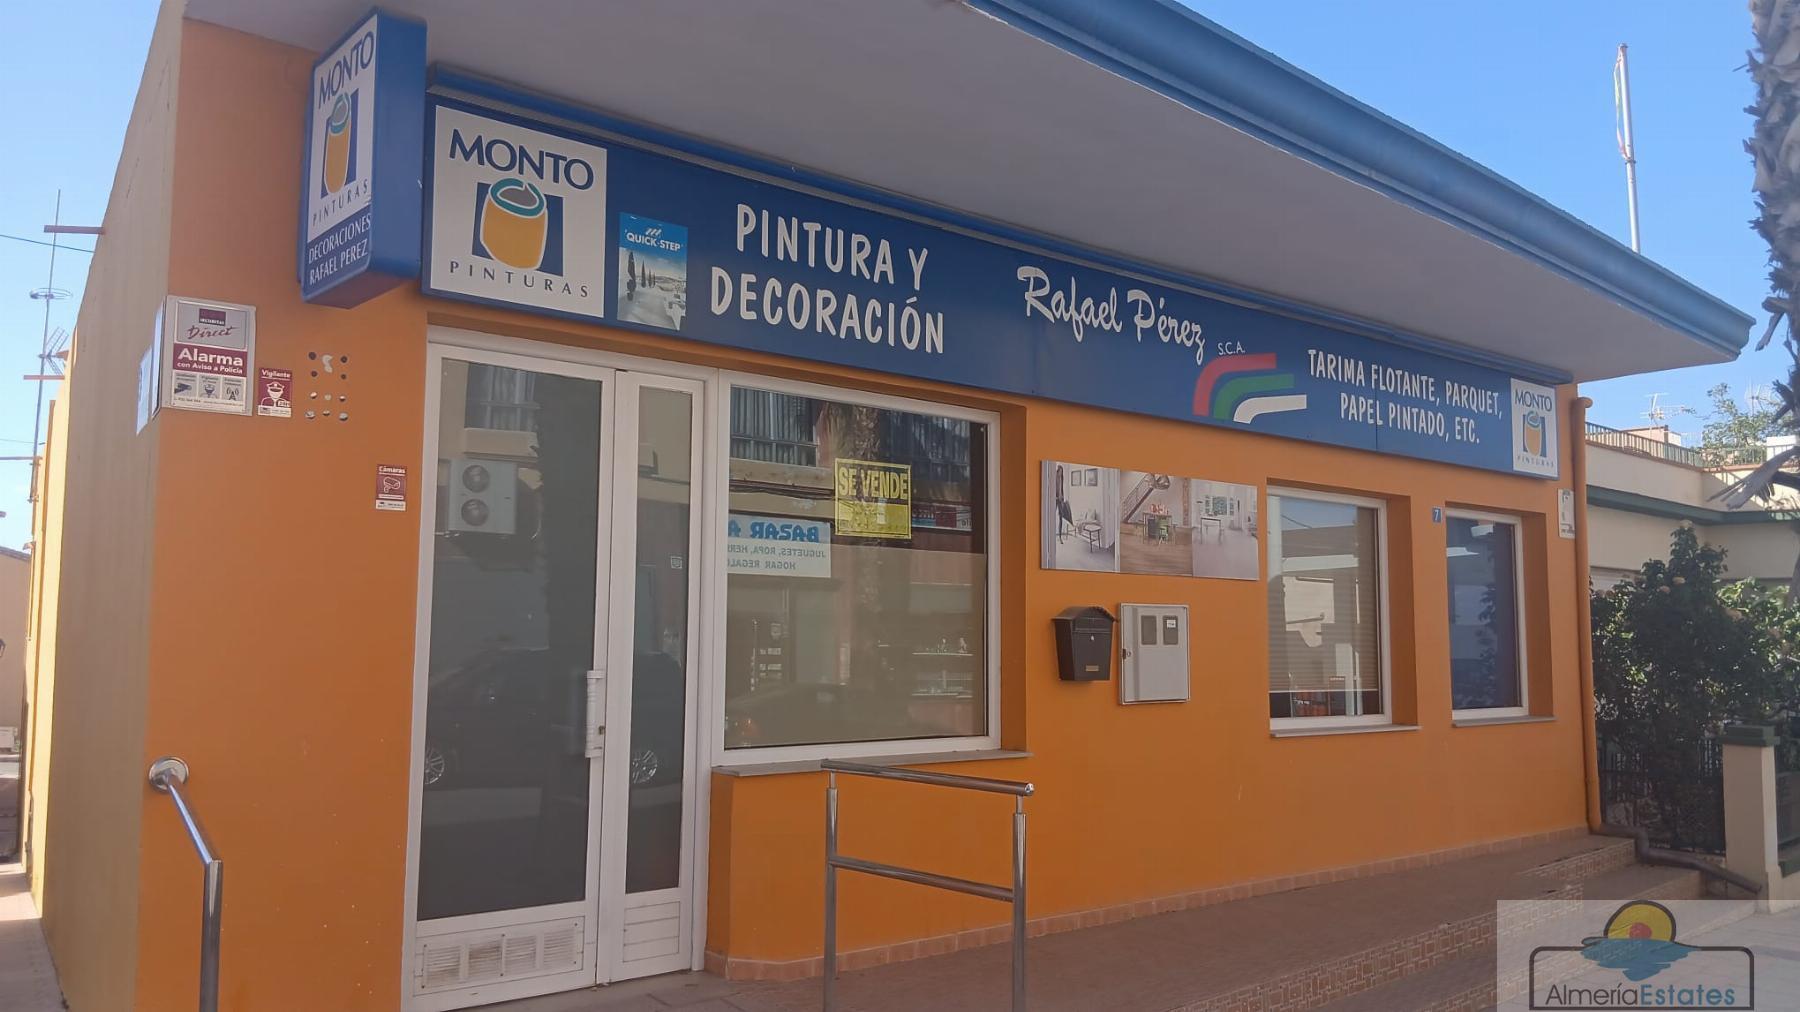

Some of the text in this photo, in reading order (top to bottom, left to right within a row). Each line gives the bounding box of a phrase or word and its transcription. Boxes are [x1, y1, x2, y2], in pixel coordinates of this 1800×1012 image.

[318, 31, 375, 110] MONTO
[449, 128, 595, 191] MONTO
[313, 179, 368, 227] PINTURAS
[308, 213, 371, 265] DECORACIONES
[309, 238, 369, 286] RAFAEL PEREZ
[626, 232, 681, 252] QUICK-STEP
[737, 203, 928, 291] PINTURA Y
[449, 261, 589, 299] PINTURAS
[187, 325, 239, 340] Direct
[711, 266, 944, 354] DECORACIÓN
[1017, 266, 1205, 366] Rafael Pérez
[178, 347, 243, 367] Alarma
[192, 363, 212, 371] Aviso
[1218, 341, 1246, 356] S.C.A.
[261, 369, 290, 378] Vigilante
[1308, 349, 1503, 420] TARIMA FLOTANTE, PARQUET,
[1340, 392, 1480, 444] PAPEL PINTADO, ETC.
[1515, 389, 1553, 412] MONTO
[839, 466, 908, 500] SE VENDE
